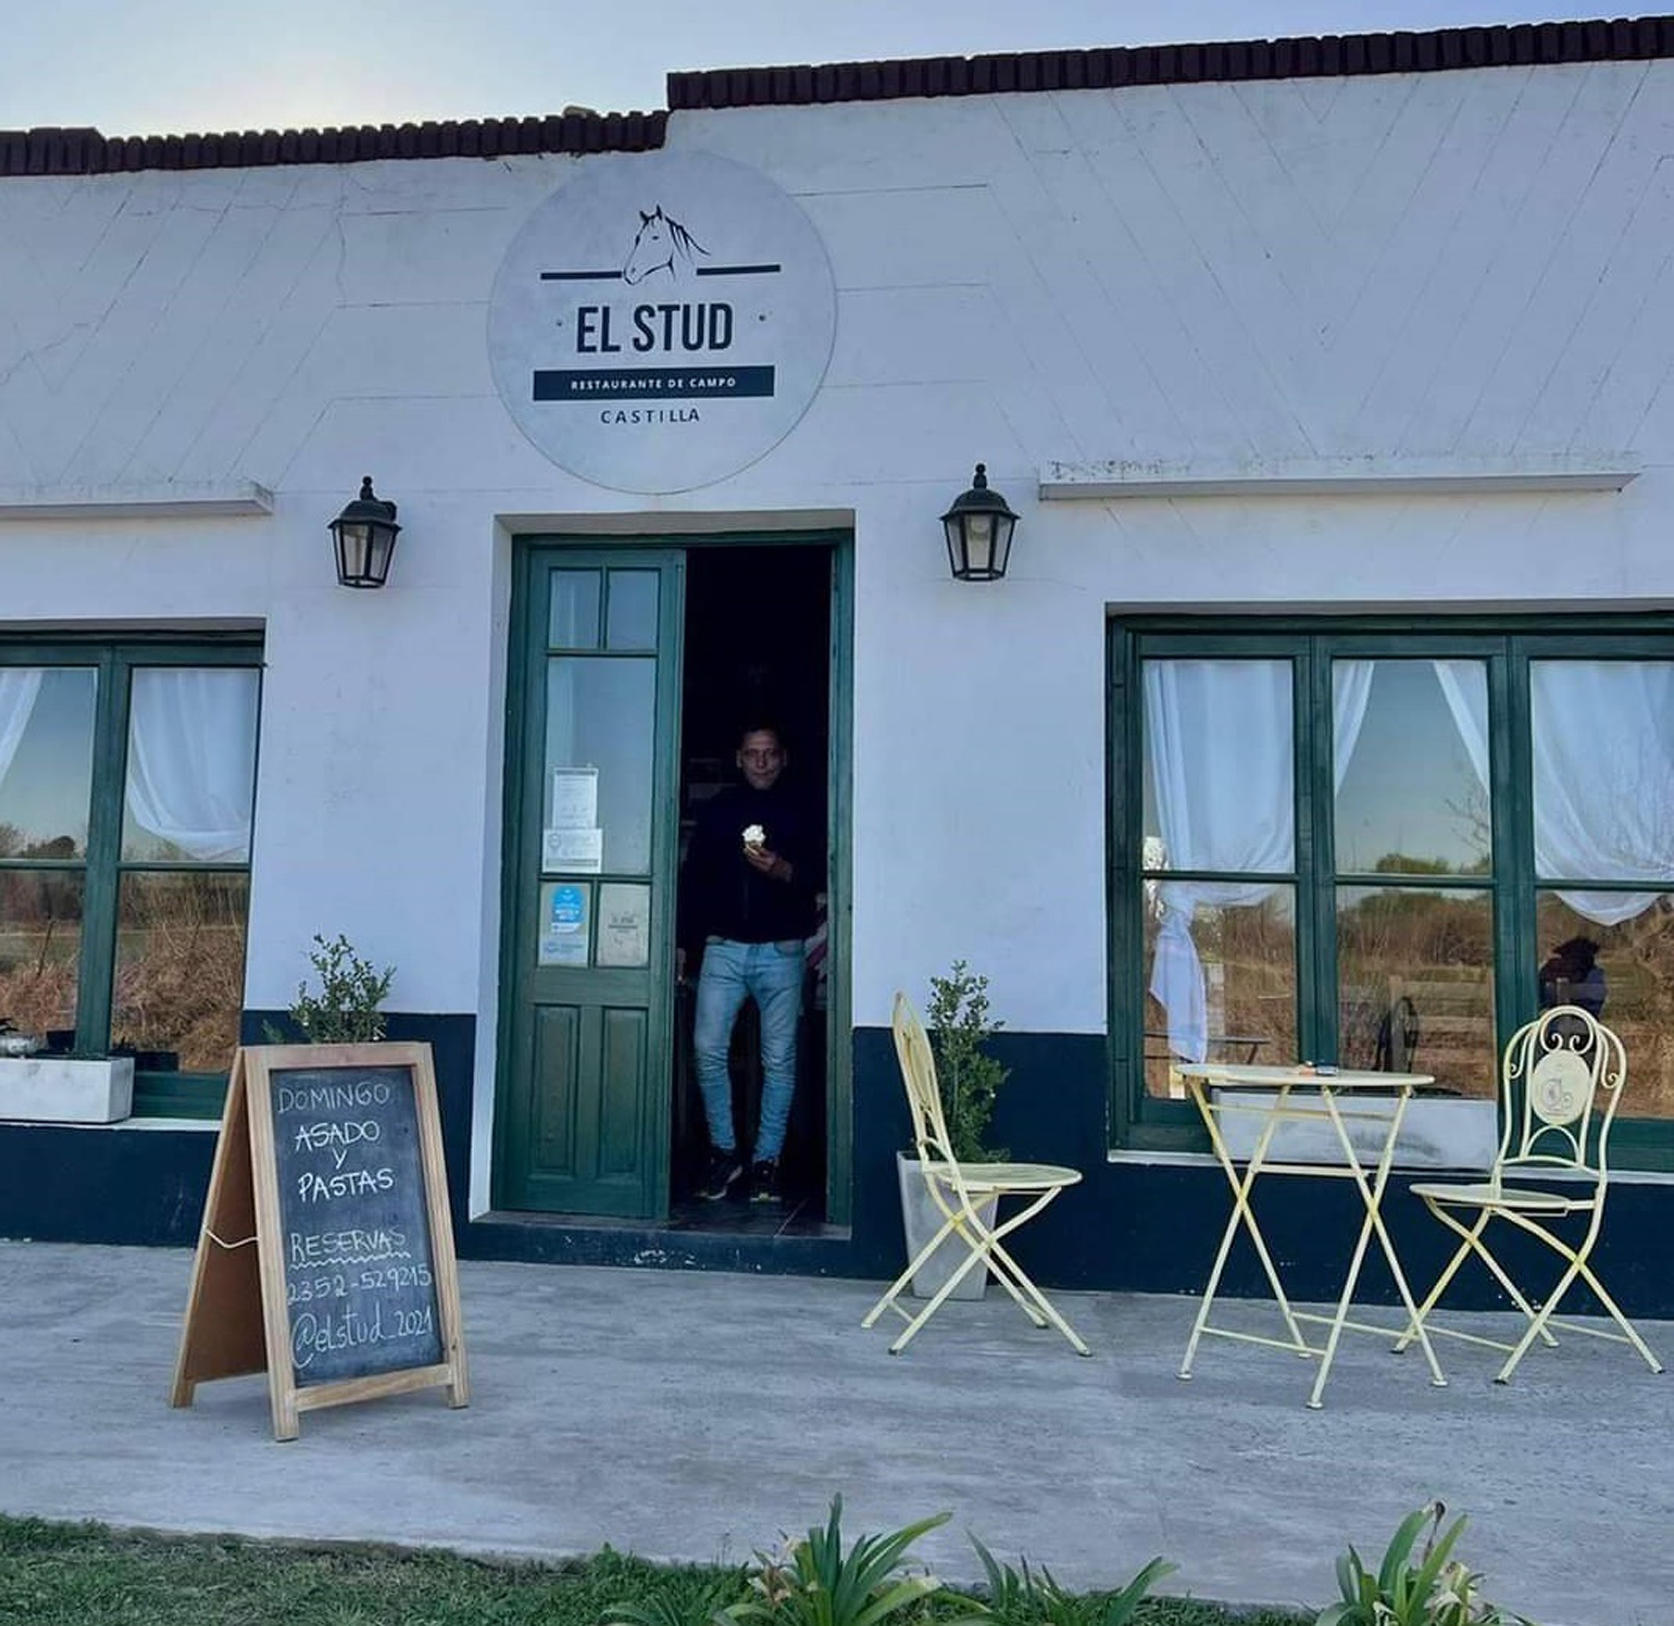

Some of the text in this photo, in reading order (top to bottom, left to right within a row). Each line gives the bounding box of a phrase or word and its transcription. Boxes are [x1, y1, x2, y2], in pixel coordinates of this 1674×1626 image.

[576, 303, 733, 353] EL STUD
[571, 377, 737, 390] RESTAURANTE DE CAMPO
[600, 408, 700, 424] CASTILLA
[277, 1081, 390, 1114] DOMINGO
[294, 1120, 380, 1151] ASADO
[297, 1168, 394, 1203] PASTAS
[290, 1227, 406, 1262] RESERVAS
